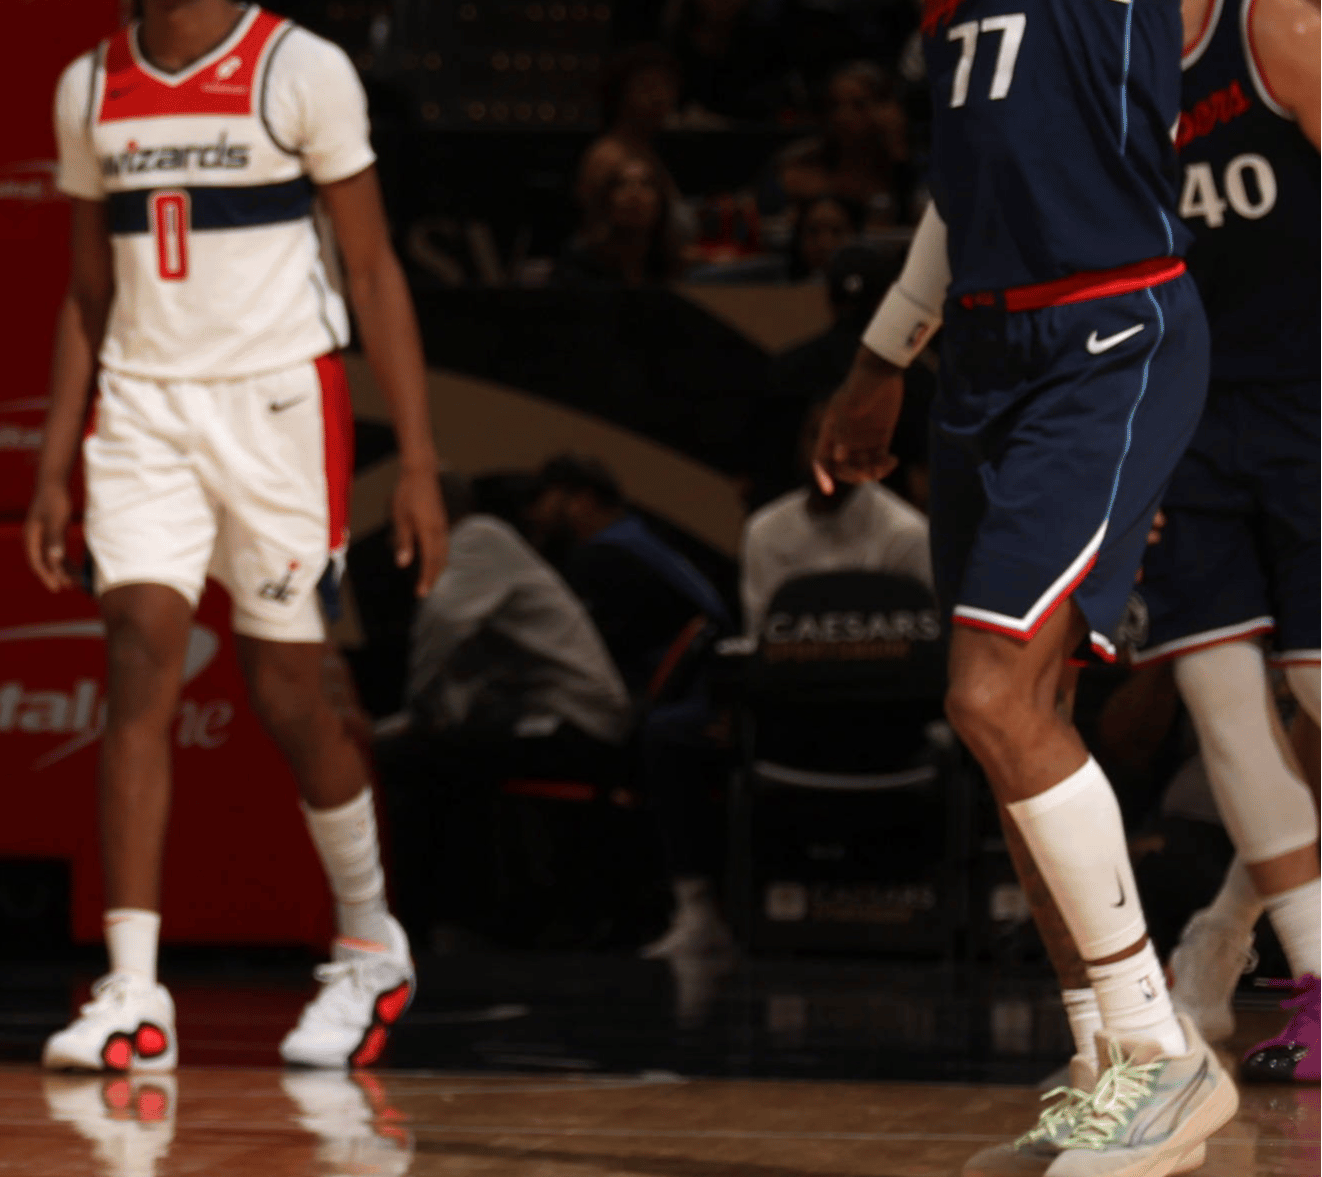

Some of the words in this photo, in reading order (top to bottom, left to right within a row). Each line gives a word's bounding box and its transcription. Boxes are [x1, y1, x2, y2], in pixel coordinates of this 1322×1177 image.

[947, 12, 1026, 108] 77
[1178, 152, 1279, 228] 40
[156, 193, 187, 280] 0
[765, 610, 941, 642] CAESARS
